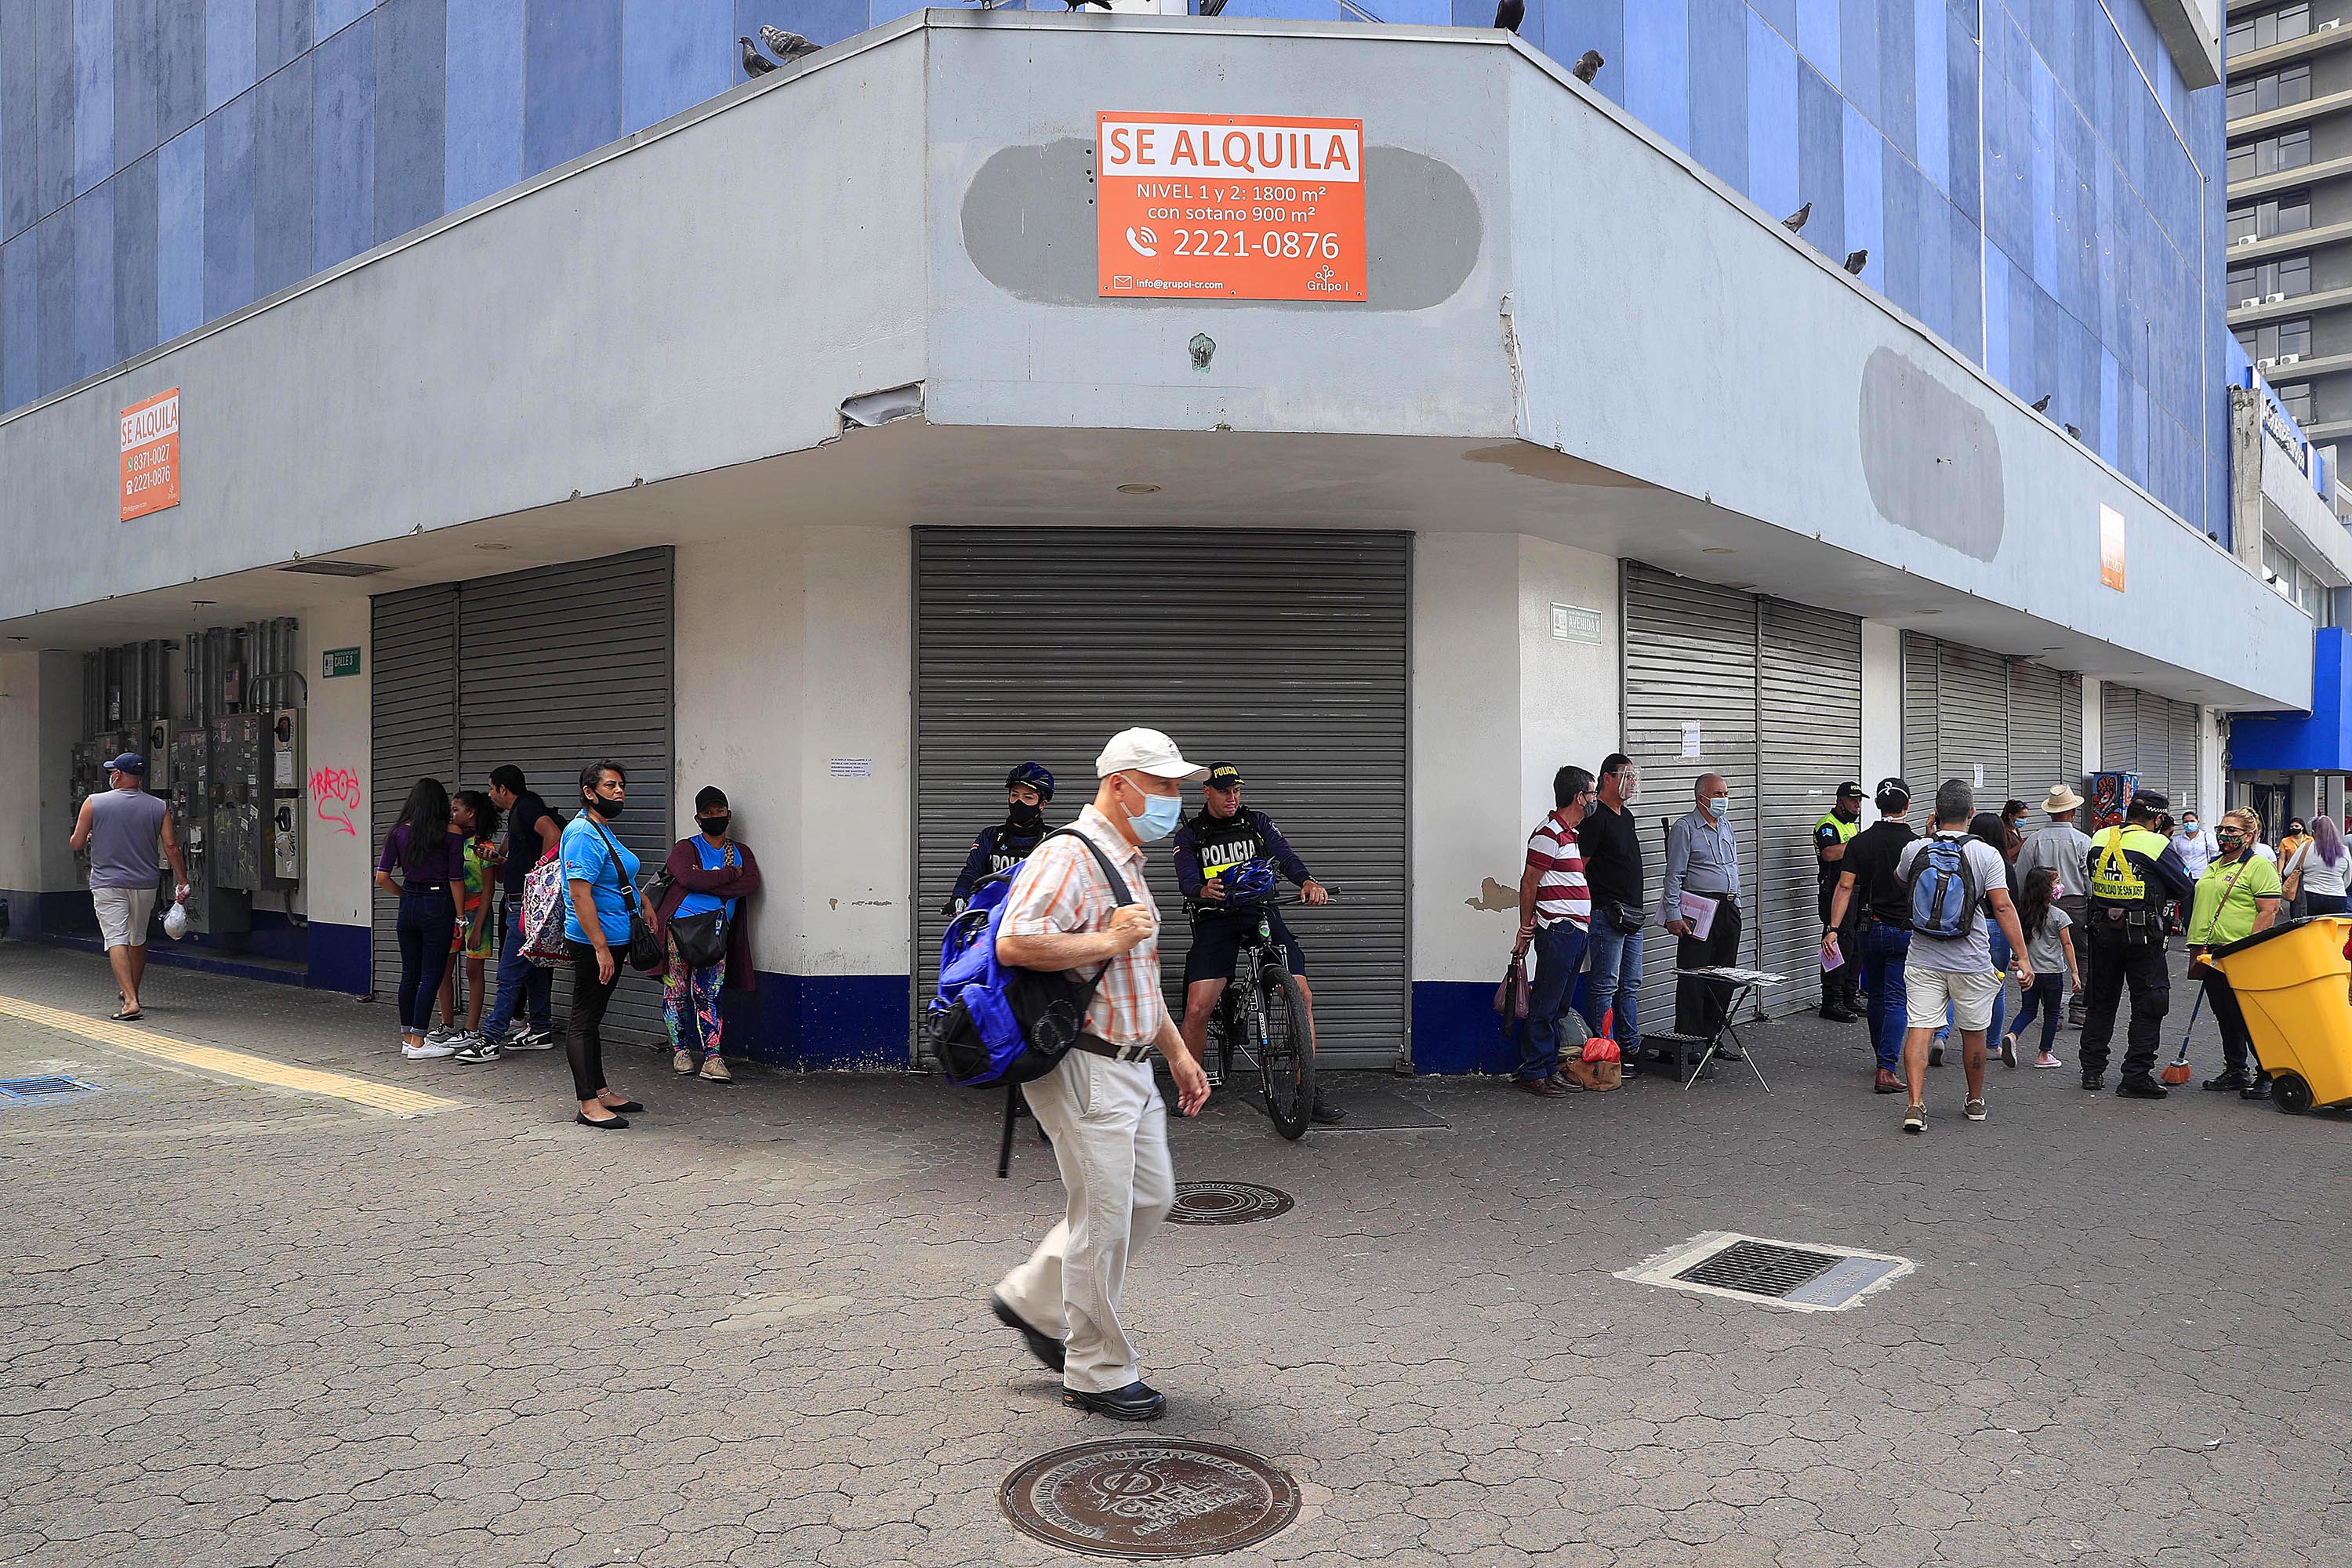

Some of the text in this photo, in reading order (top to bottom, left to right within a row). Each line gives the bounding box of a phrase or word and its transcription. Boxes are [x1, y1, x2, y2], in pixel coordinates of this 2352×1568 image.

[1110, 128, 1351, 173] SE ALQUILA
[1137, 183, 1192, 199] NIVEL
[1200, 185, 1209, 199] 1
[1214, 188, 1225, 203] y
[1230, 186, 1247, 201] 2:
[1253, 187, 1296, 201] 1800
[1148, 207, 1180, 220] con
[1185, 207, 1247, 221] sotano
[1252, 206, 1286, 222] 900
[1174, 229, 1340, 260] 2221-0876
[1136, 279, 1224, 289] info@grupoi-cr.com
[1307, 280, 1341, 292] Grupo
[122, 401, 177, 446] SE ALQUILA
[133, 443, 170, 471] 8371-0027
[133, 465, 170, 493] 2221-0876
[1569, 615, 1595, 632] AVENIDA
[335, 656, 348, 667] CALLE
[1214, 766, 1238, 778] POLICIA
[1202, 839, 1256, 866] POLICIA
[1074, 1457, 1102, 1468] DE
[1103, 1450, 1174, 1461] FUERZA
[1178, 1452, 1190, 1461] Y
[1133, 1515, 1177, 1536] ALTO
